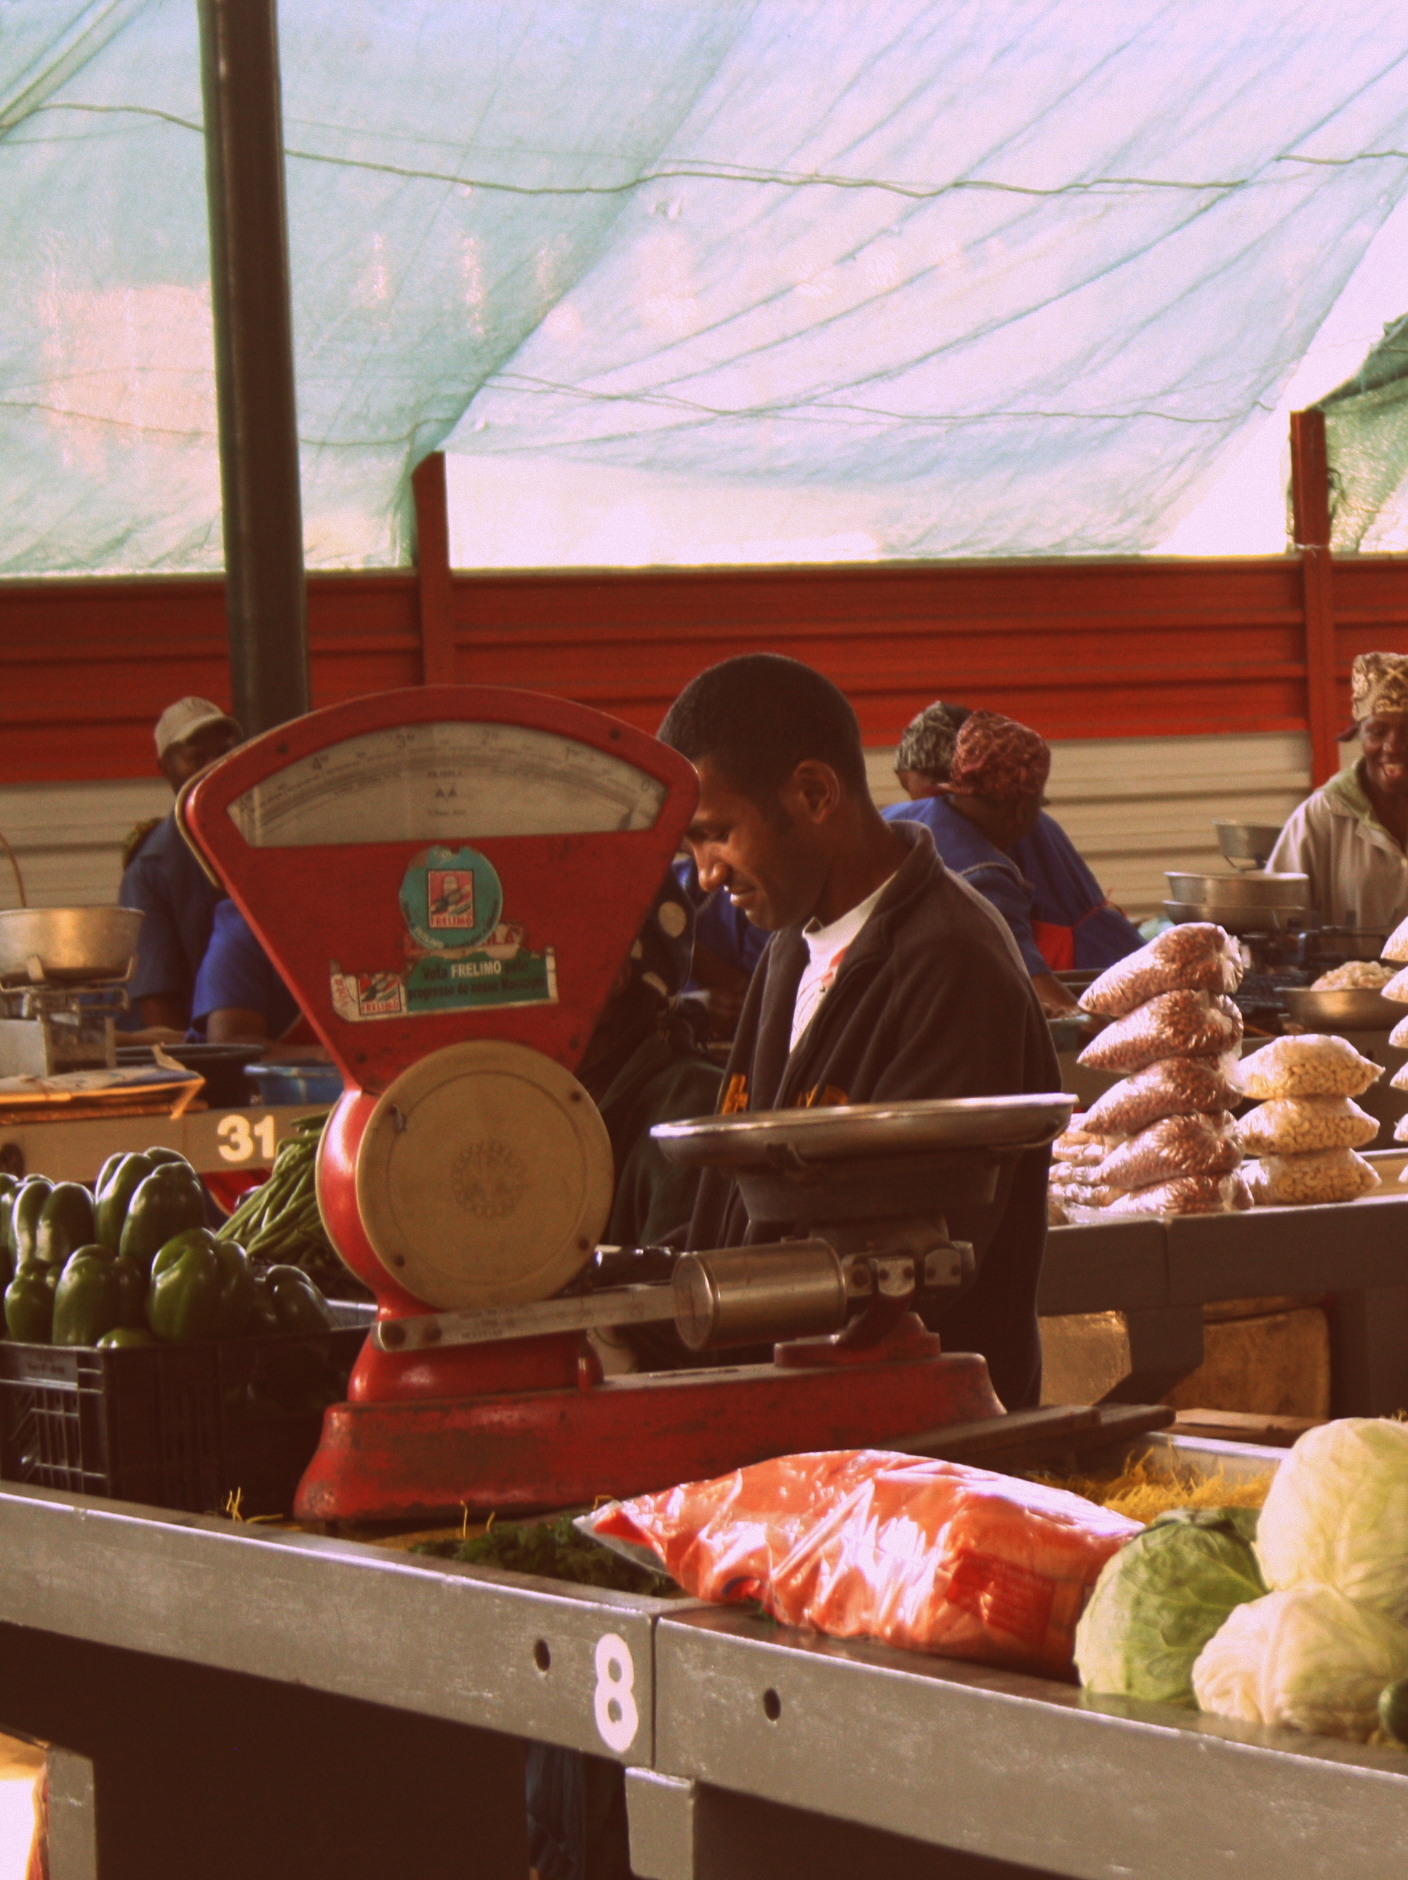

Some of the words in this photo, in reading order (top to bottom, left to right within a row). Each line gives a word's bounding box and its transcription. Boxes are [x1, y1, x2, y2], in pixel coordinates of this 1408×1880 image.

[431, 914, 473, 926] FRELIMO
[451, 960, 502, 978] FRELIMO
[217, 1114, 275, 1162] 31
[594, 1632, 639, 1752] 8
